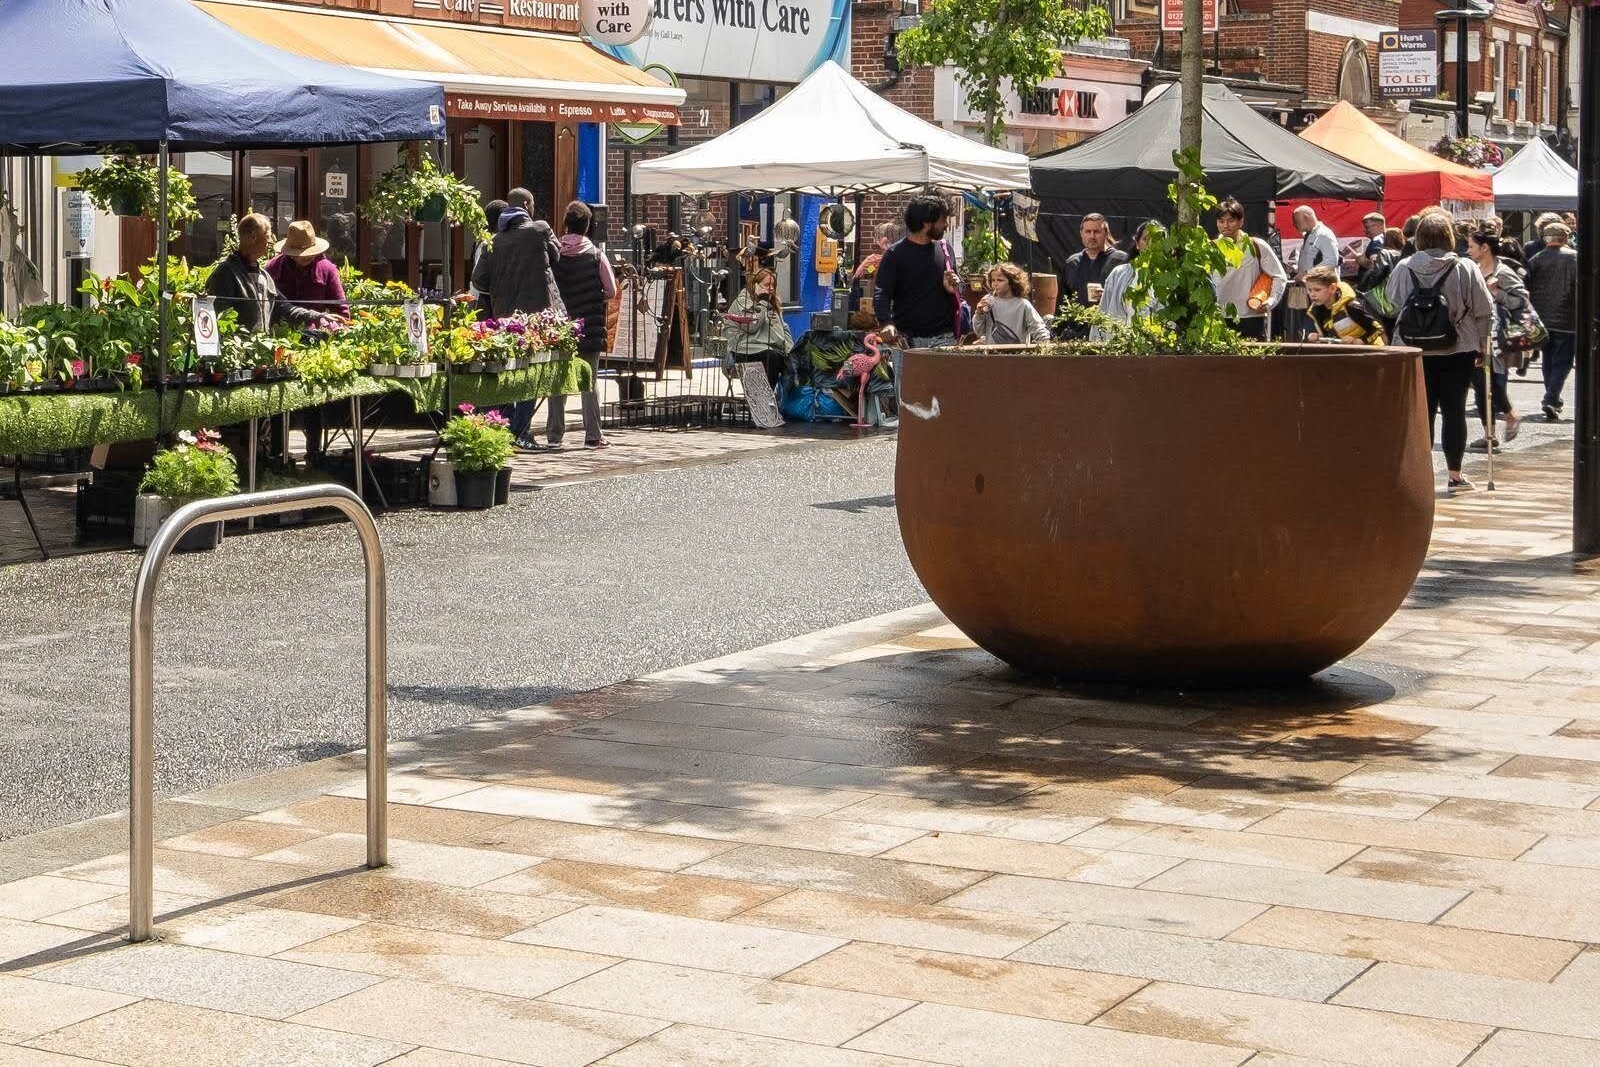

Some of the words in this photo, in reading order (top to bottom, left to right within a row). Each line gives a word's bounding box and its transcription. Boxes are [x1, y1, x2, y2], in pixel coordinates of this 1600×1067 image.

[598, 2, 630, 16] with
[596, 19, 631, 34] Care
[1384, 75, 1402, 84] TO
[1407, 75, 1430, 83] LET
[458, 99, 473, 111] Take
[475, 100, 492, 113] Away
[493, 101, 518, 112] Service
[518, 102, 546, 114] Available
[559, 103, 592, 117] Espresso
[610, 106, 626, 116] Latte
[1077, 91, 1100, 119] UK
[699, 109, 709, 127] 27
